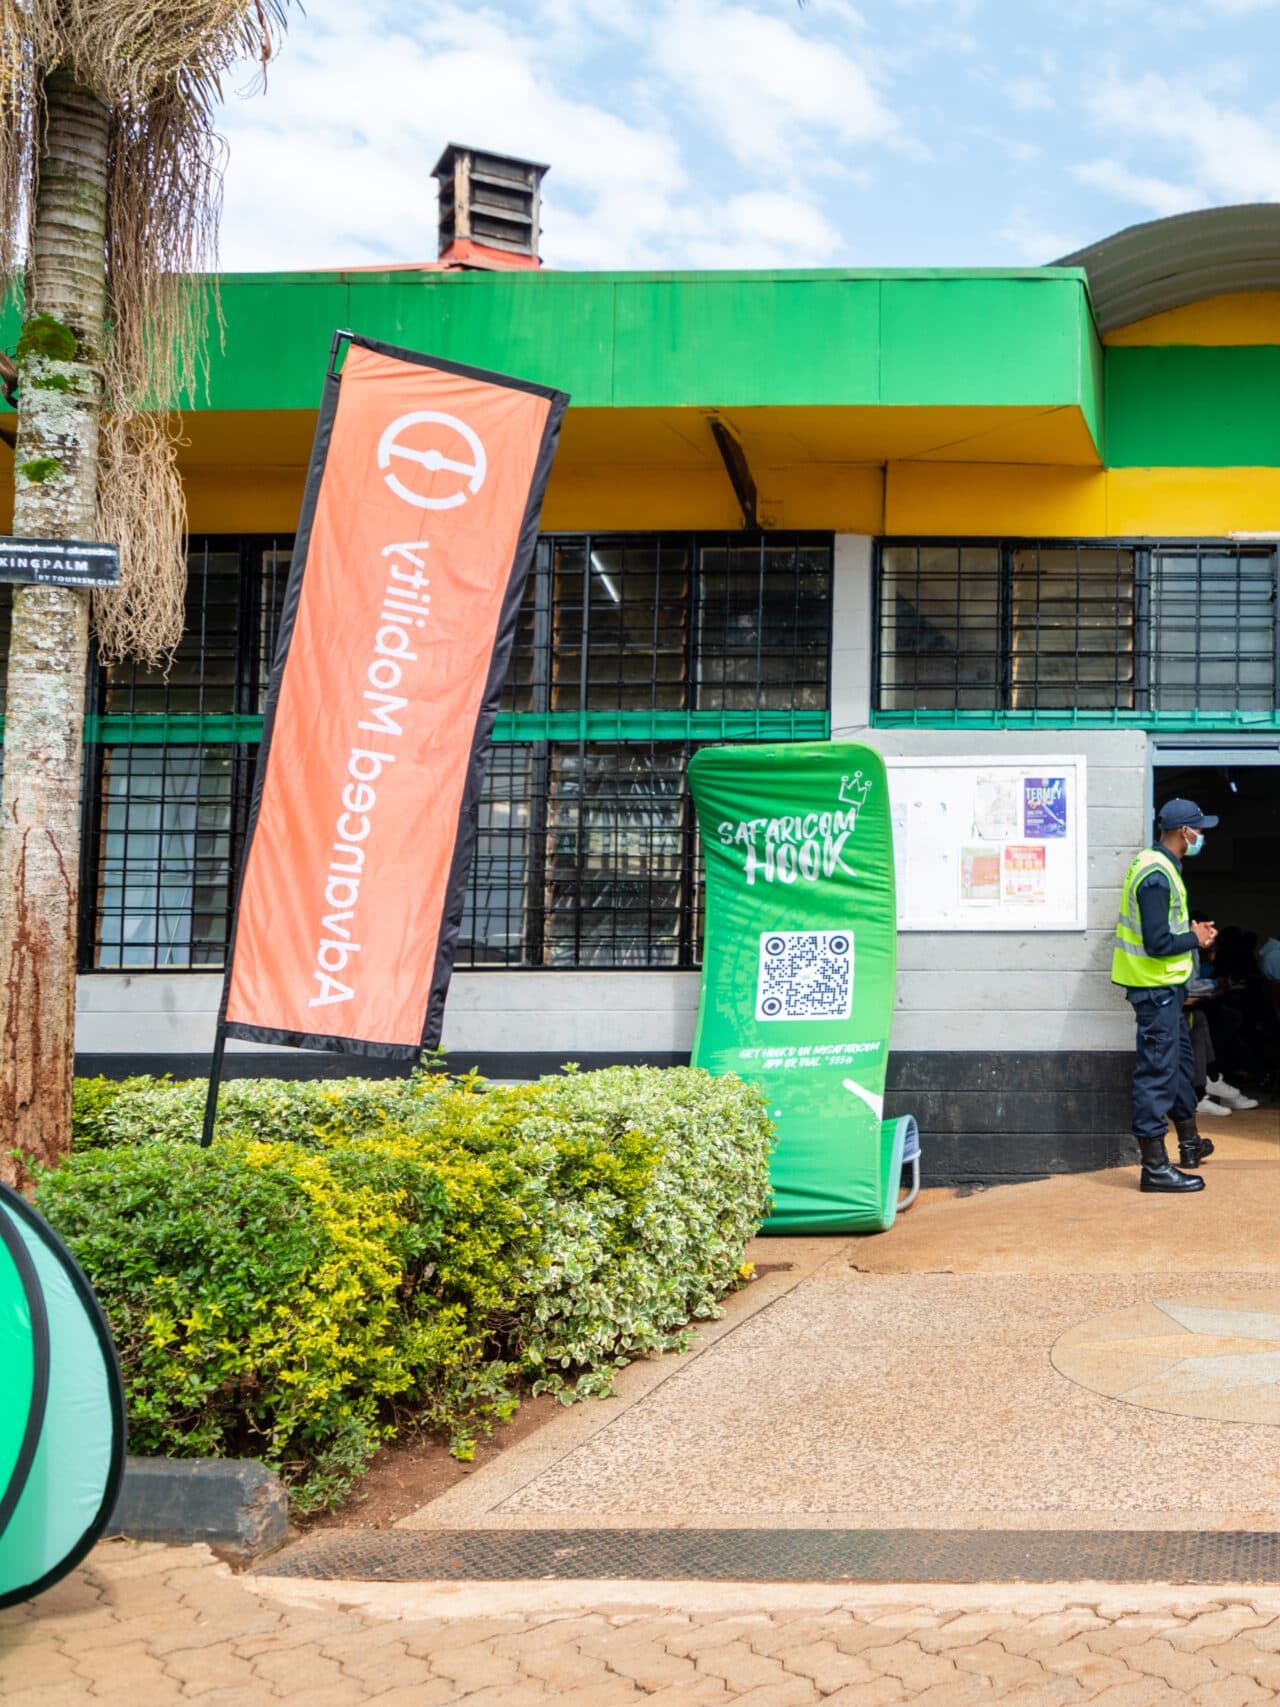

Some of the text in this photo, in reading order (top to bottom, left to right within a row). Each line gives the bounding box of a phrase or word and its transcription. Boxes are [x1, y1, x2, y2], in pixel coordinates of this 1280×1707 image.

[717, 809, 857, 845] SAFARICOM
[743, 831, 857, 885] HOOK
[739, 1048, 760, 1059] GET
